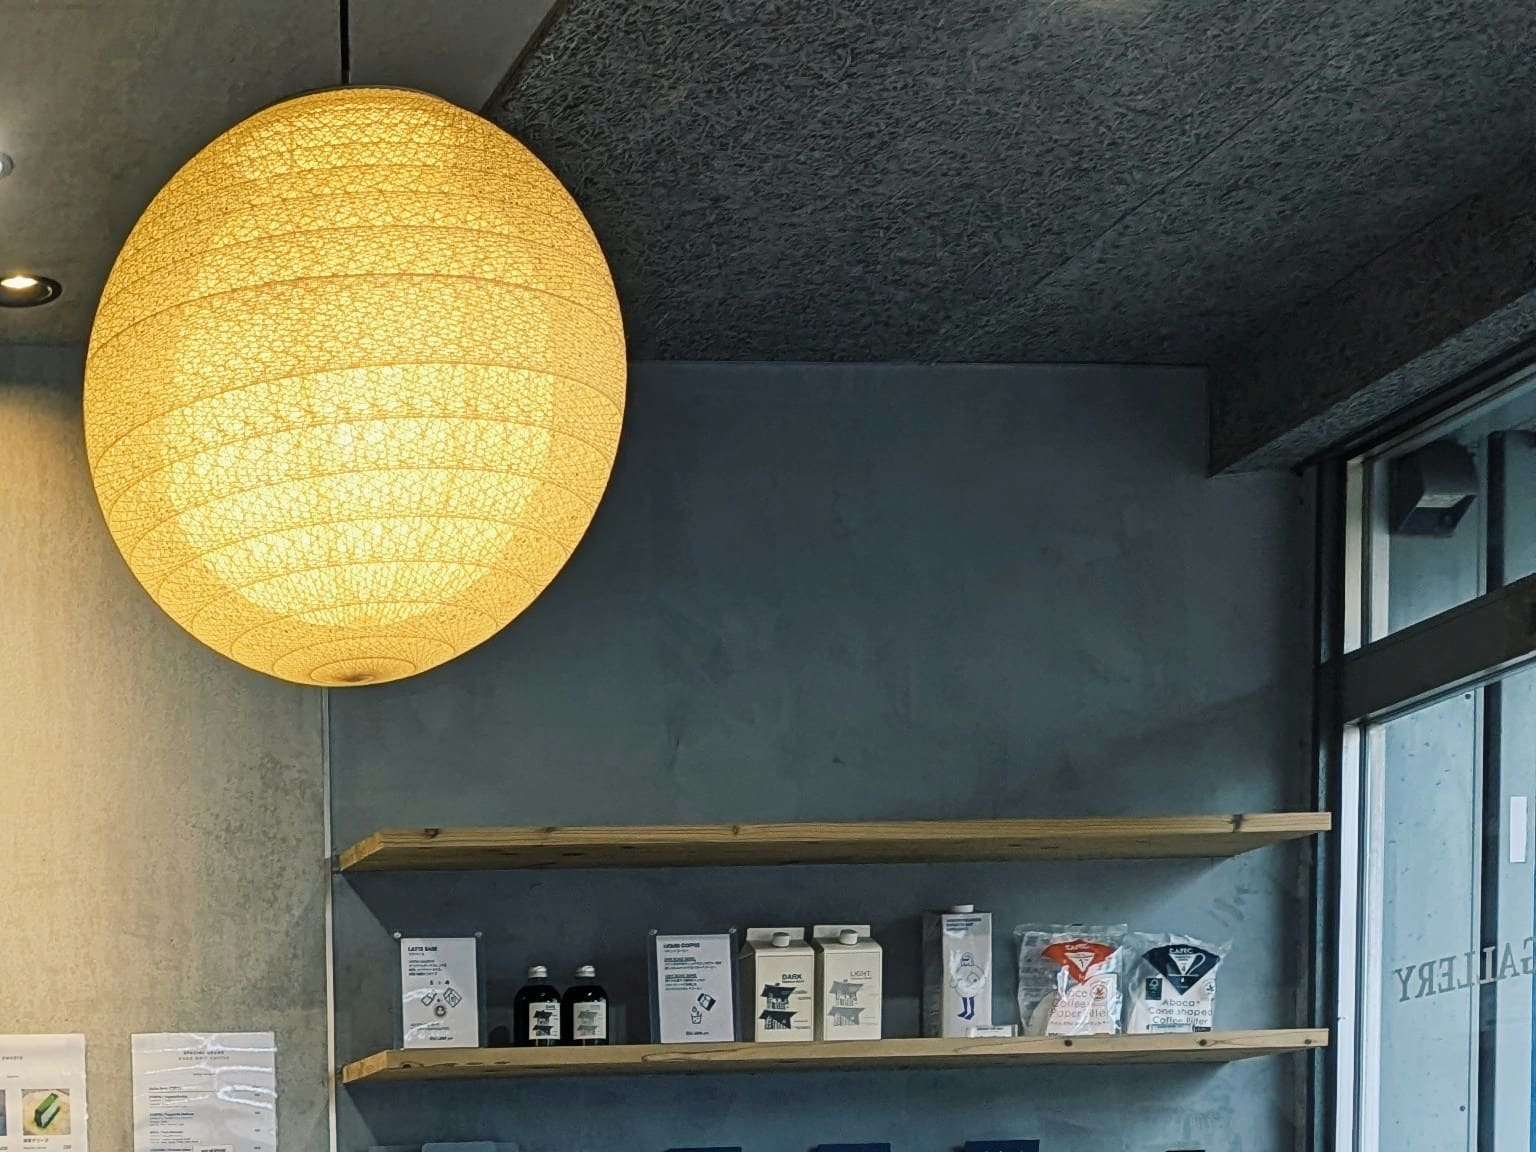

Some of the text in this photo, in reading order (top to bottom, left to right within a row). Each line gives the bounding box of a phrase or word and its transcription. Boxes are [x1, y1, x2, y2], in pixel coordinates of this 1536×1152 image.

[781, 973, 802, 981] DARK
[849, 970, 872, 978] LIGHT
[1148, 1006, 1213, 1017] Cone shaped
[1152, 1015, 1184, 1025] Coffee
